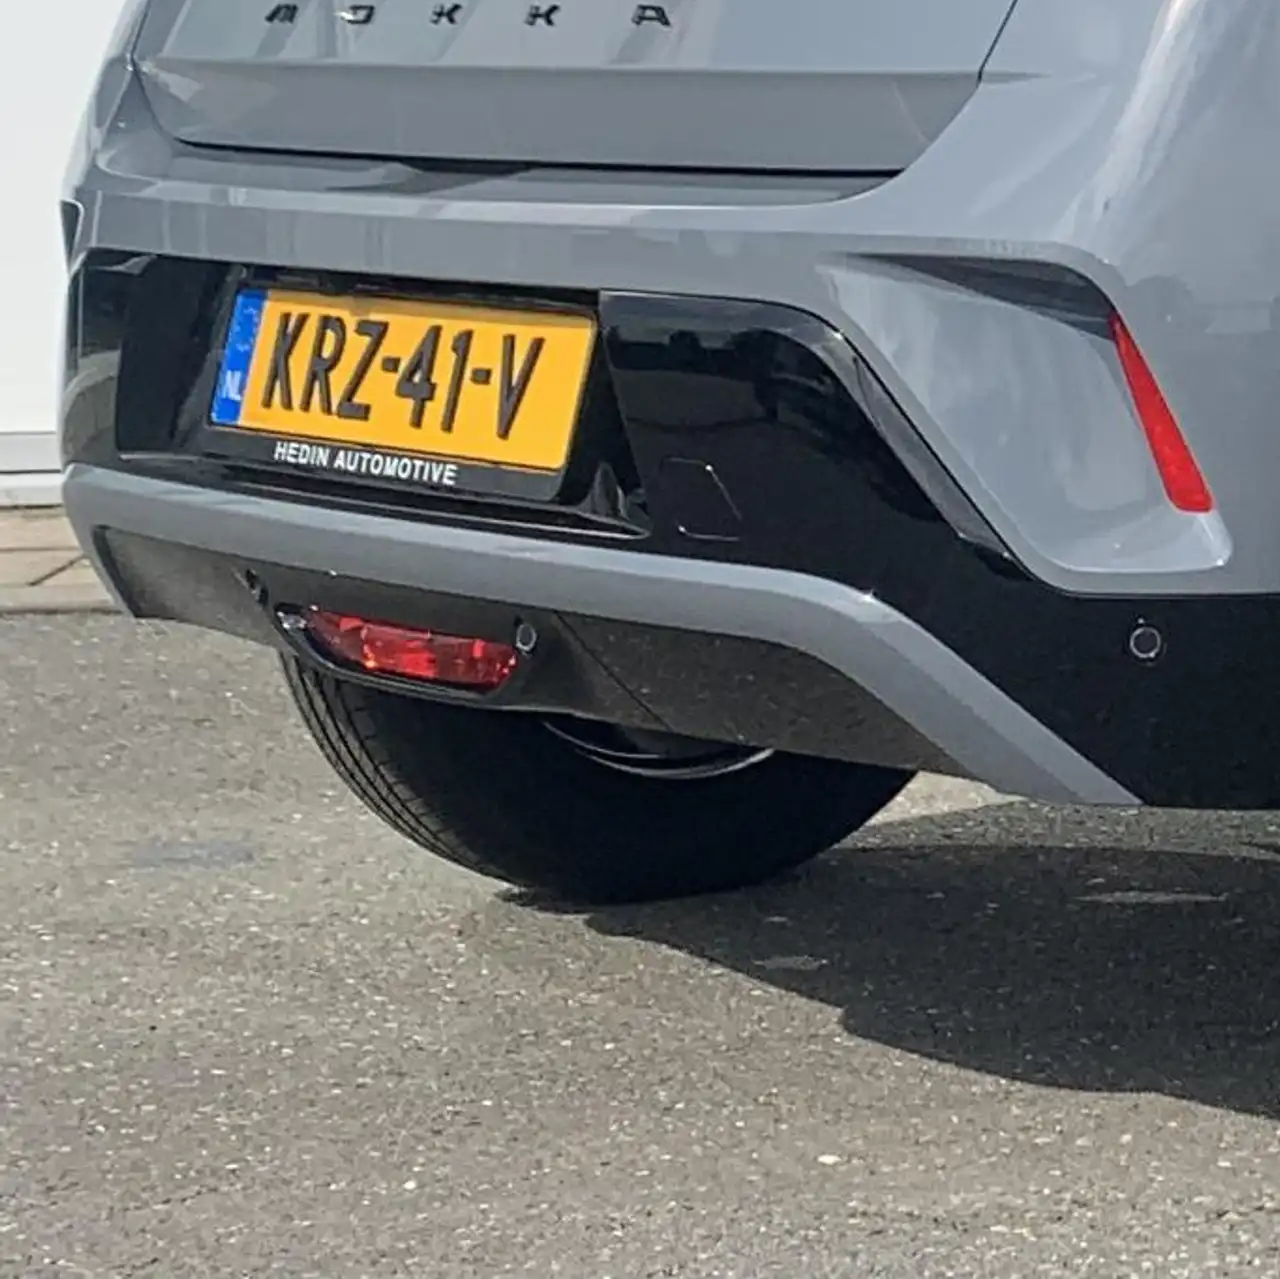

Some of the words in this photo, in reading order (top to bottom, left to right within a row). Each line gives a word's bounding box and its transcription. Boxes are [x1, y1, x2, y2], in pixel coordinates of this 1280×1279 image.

[265, 3, 671, 26] MOKKA
[220, 369, 242, 401] NL
[262, 312, 545, 440] KRZ-41-V
[274, 442, 328, 467] HEDIN
[333, 450, 458, 485] AUTOMOTIVE
